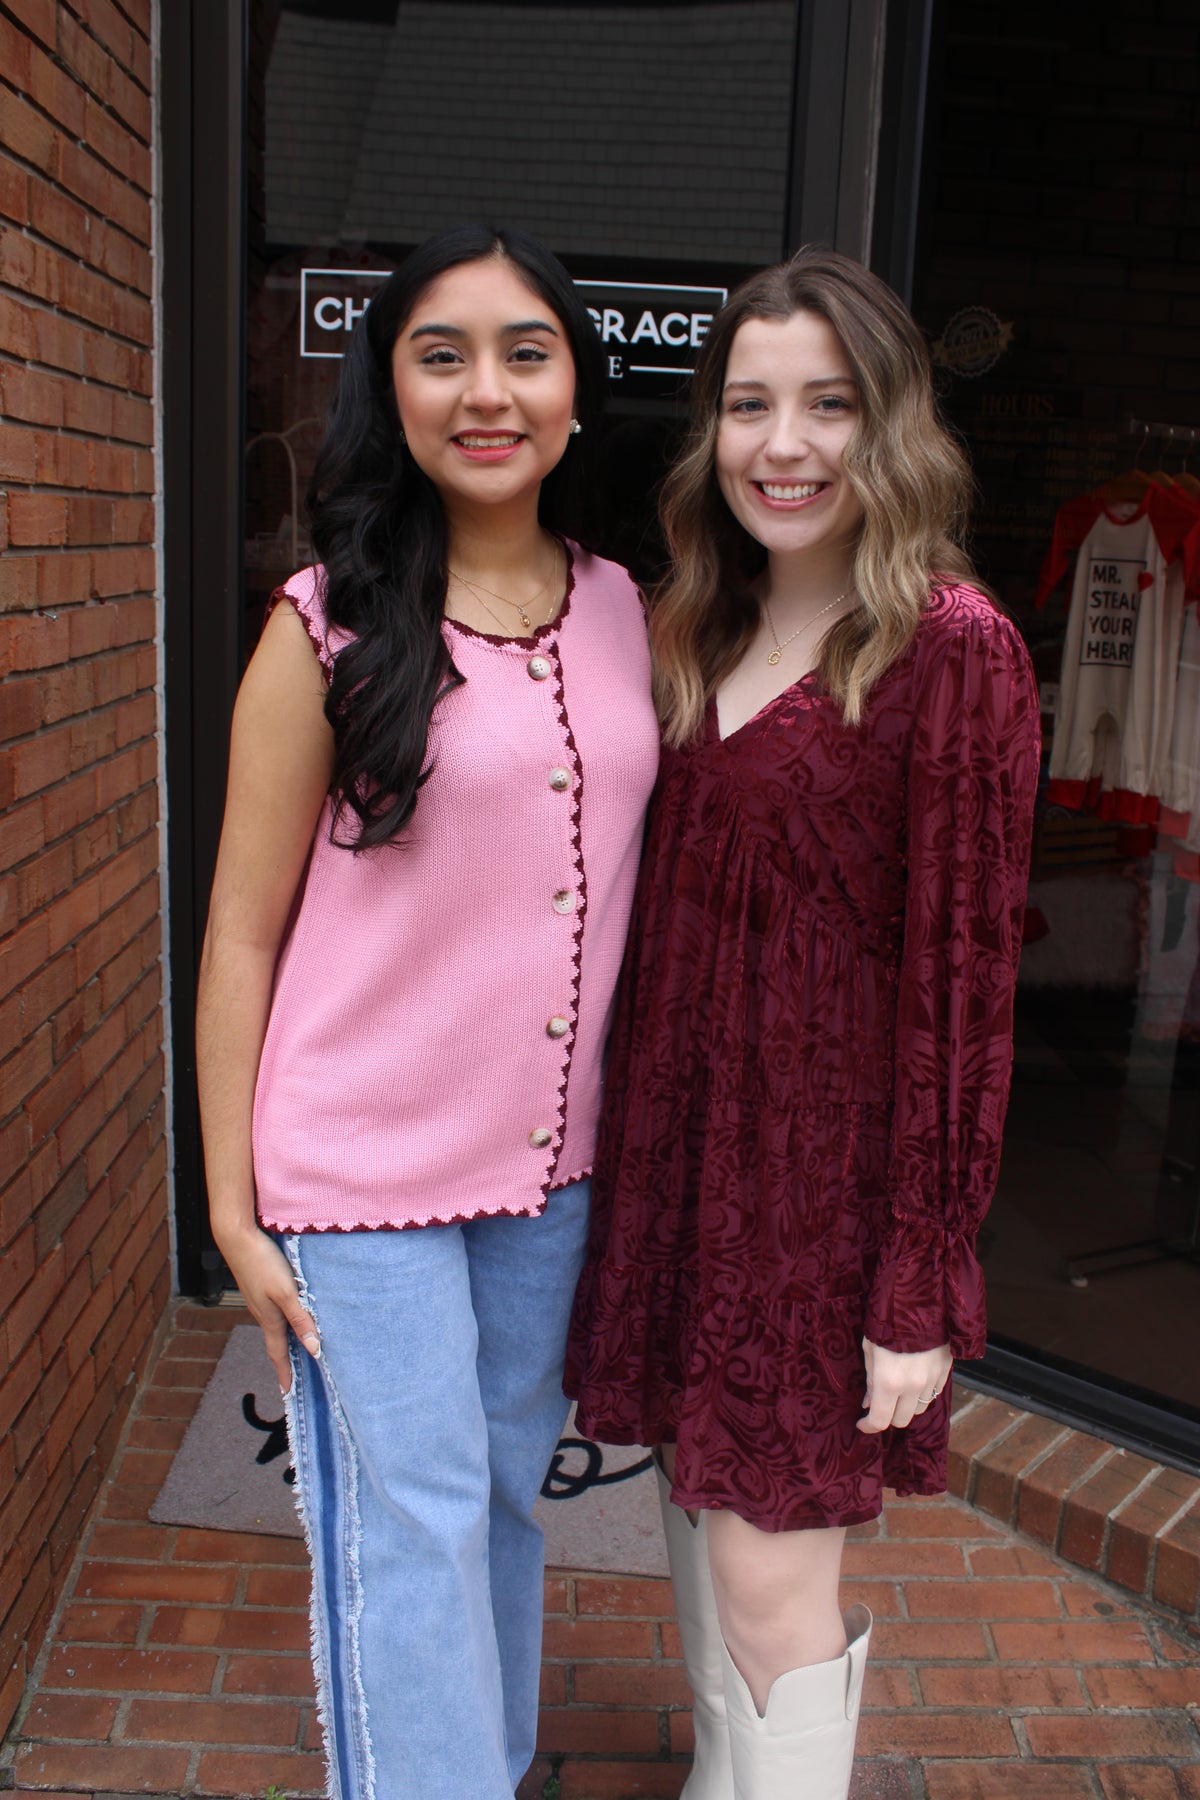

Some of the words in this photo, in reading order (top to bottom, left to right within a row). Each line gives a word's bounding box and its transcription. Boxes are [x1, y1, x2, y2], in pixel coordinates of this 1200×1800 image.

[981, 393, 1056, 416] HOURS
[1092, 565, 1122, 585] MR.
[1089, 590, 1137, 611] STEAL
[1088, 616, 1134, 637] YOUR
